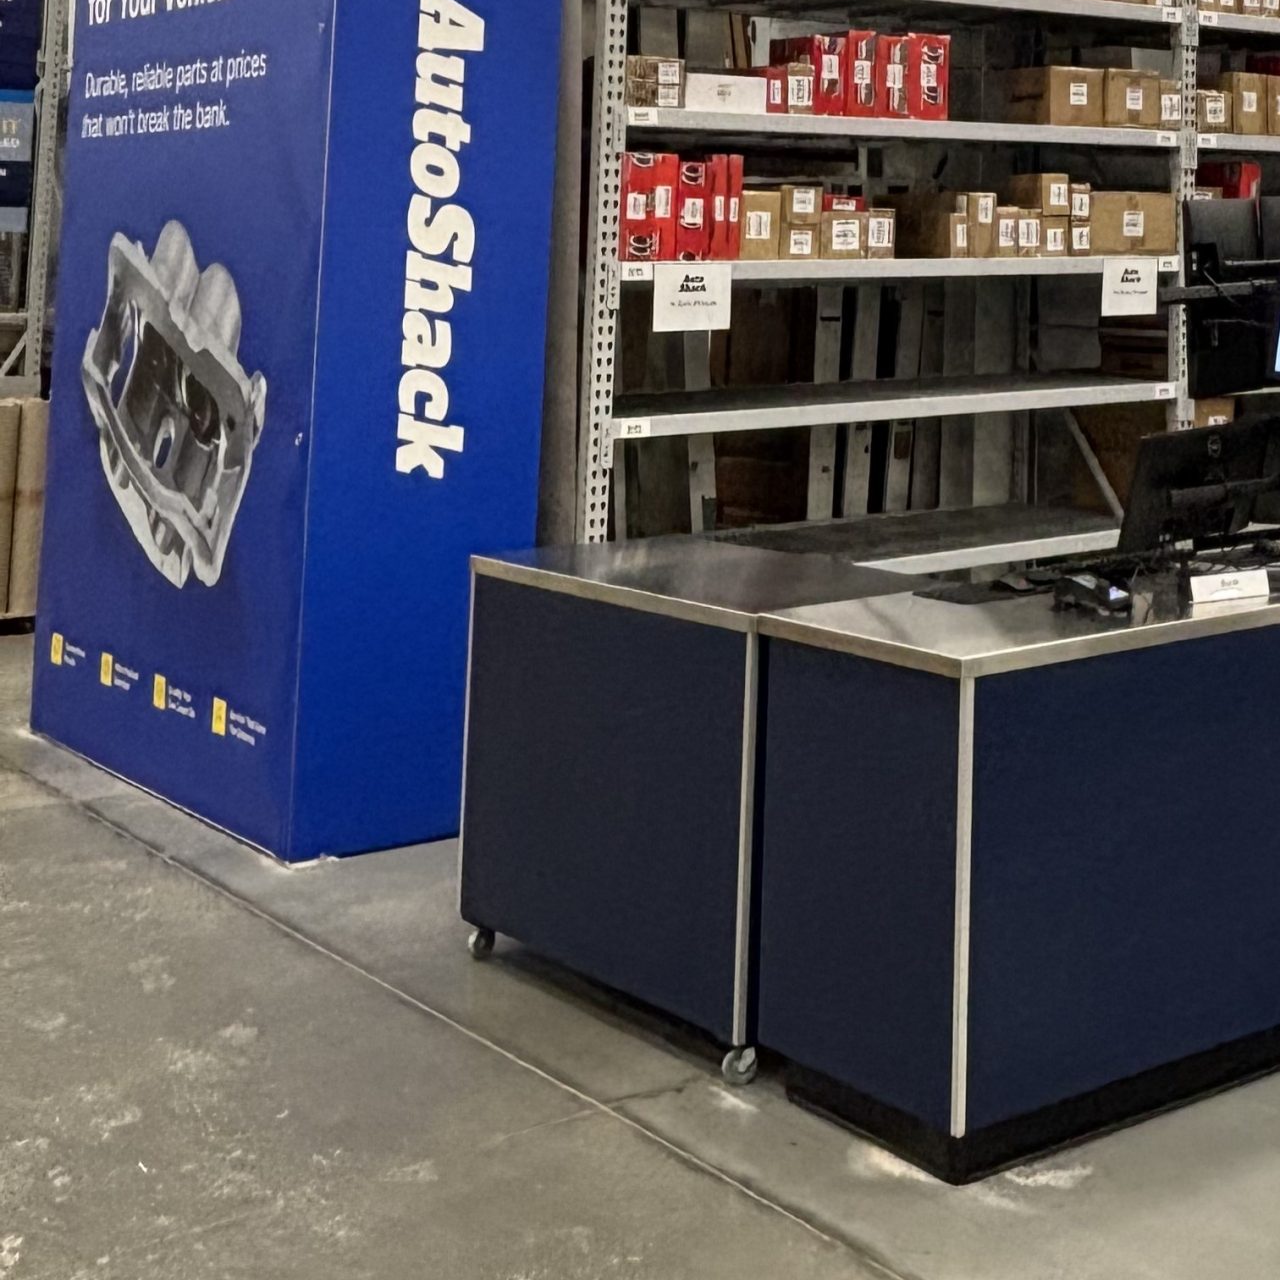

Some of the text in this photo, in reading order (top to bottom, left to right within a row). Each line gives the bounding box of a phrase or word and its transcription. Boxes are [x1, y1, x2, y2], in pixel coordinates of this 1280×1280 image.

[85, 48, 267, 99] Durable, reliable parts at prices
[137, 104, 170, 134] break
[173, 101, 193, 131] the
[195, 98, 230, 128] bank.
